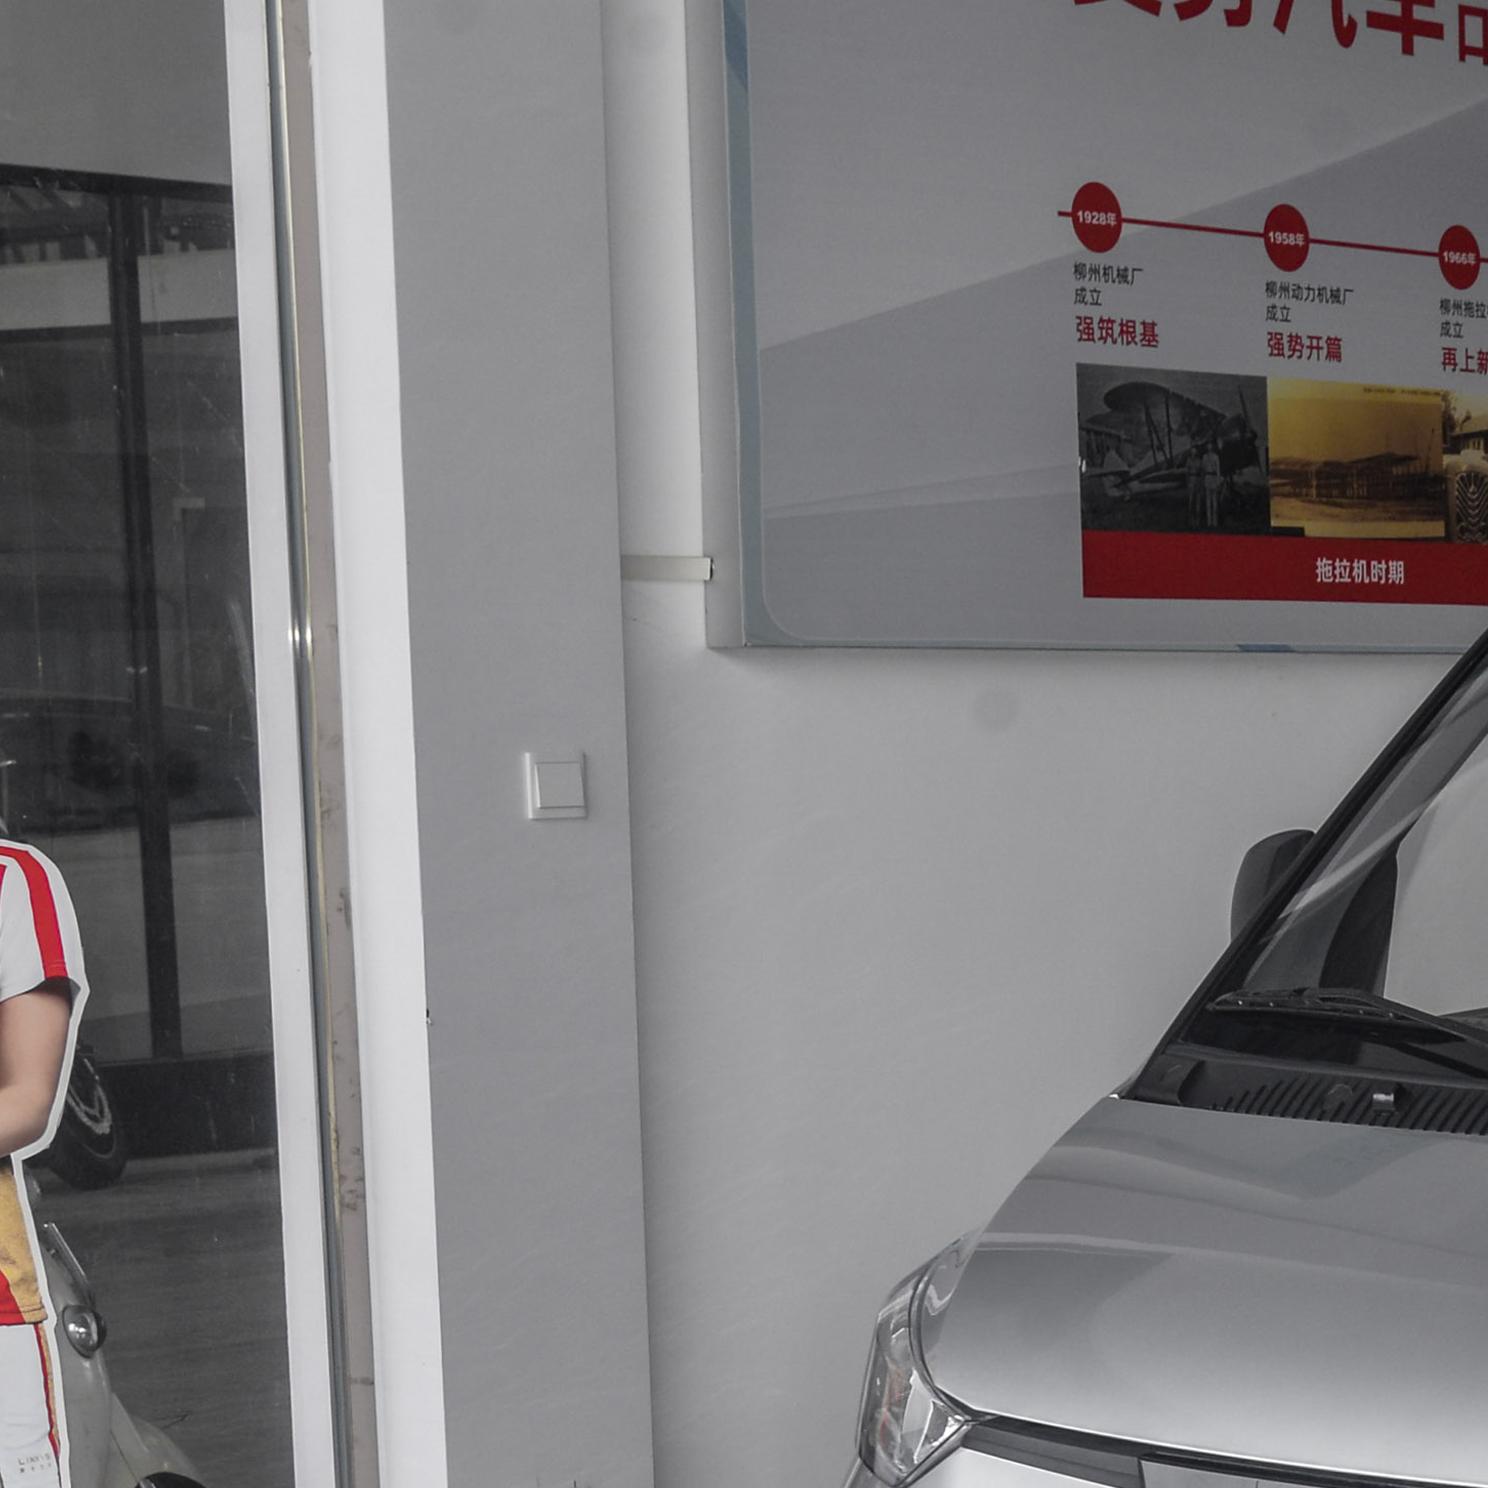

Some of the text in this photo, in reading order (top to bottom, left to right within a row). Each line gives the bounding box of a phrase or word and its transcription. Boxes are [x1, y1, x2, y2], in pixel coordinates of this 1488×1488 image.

[1076, 210, 1118, 226] 1928年
[1268, 231, 1305, 247] 1958年
[1443, 251, 1477, 266] 1966年
[1073, 262, 1144, 285] 柳州机械厂
[1074, 287, 1102, 306] 成立
[1265, 280, 1355, 305] 柳州动力机械厂
[1265, 305, 1292, 323] 成立
[1075, 315, 1160, 348] 强筑根基
[1440, 321, 1464, 338] 成立
[1267, 332, 1343, 362] 强势开篇
[1315, 557, 1405, 585] 拖拉机时期
